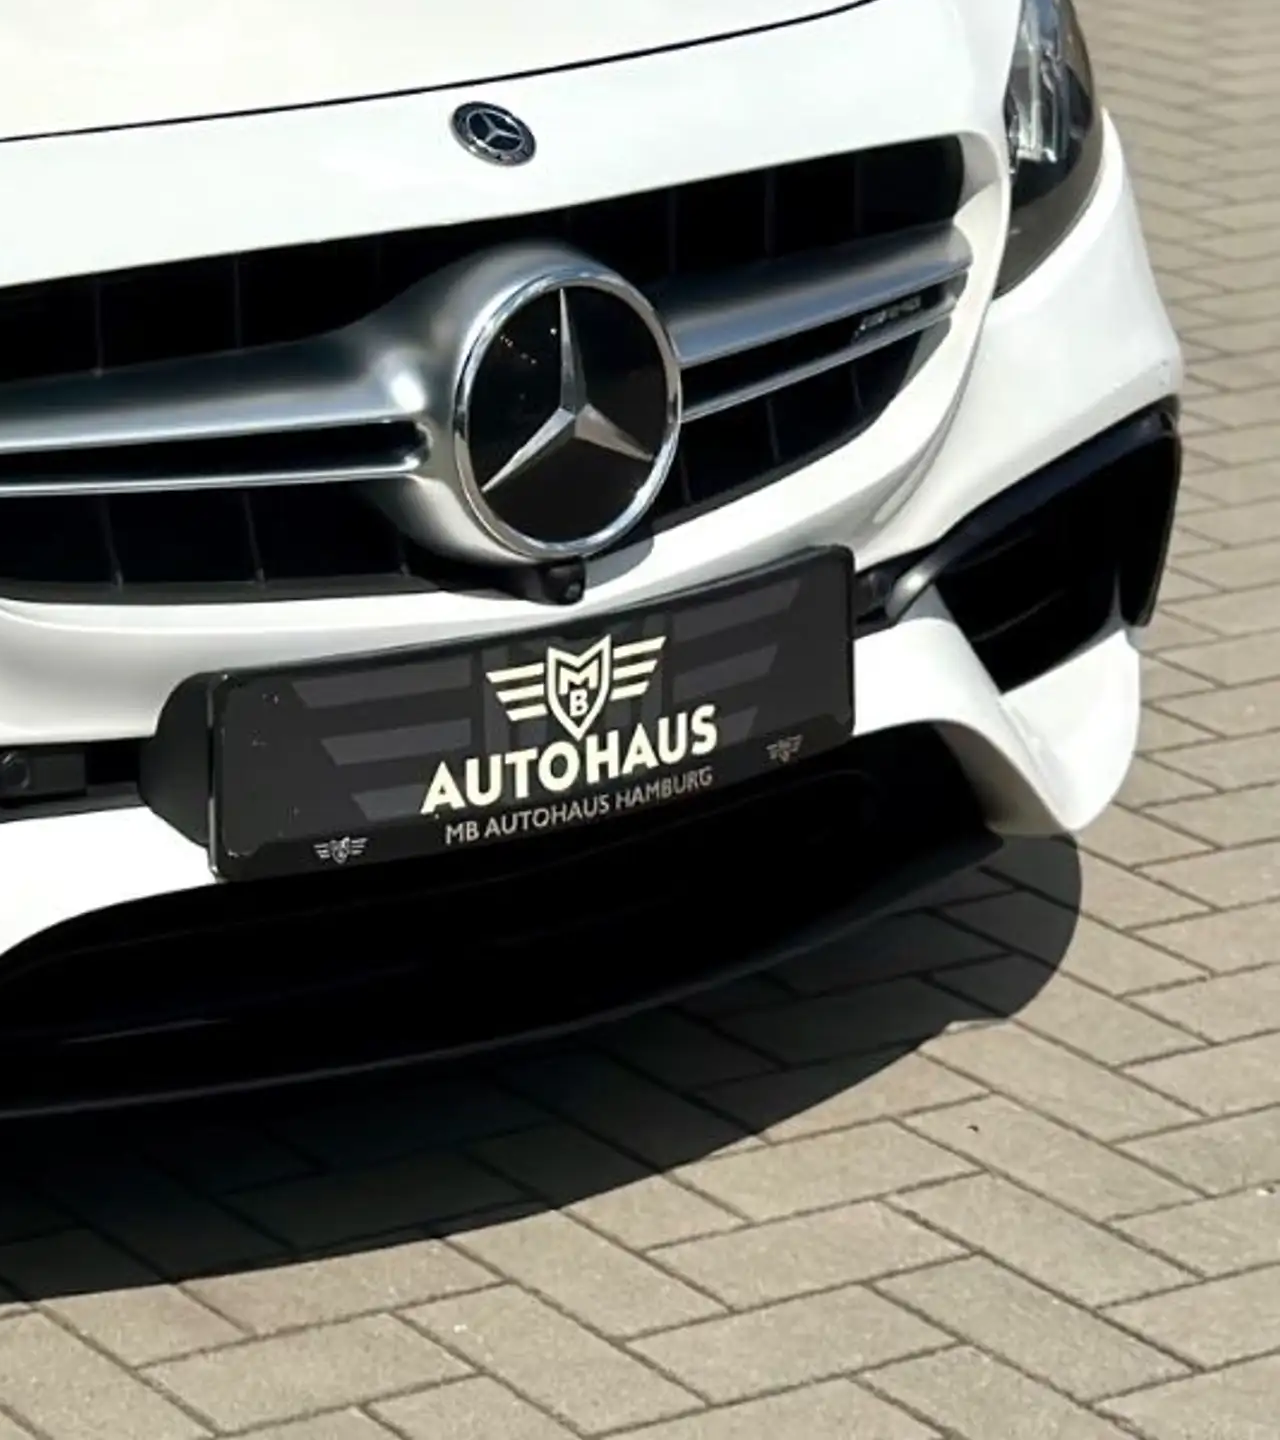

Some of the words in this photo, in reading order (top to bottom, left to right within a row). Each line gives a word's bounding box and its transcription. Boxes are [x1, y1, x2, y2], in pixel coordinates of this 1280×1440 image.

[420, 705, 718, 815] AUTOHAUS
[445, 820, 480, 846] MB
[484, 793, 610, 839] AUTOHAUS
[615, 766, 713, 810] HAMBURG
